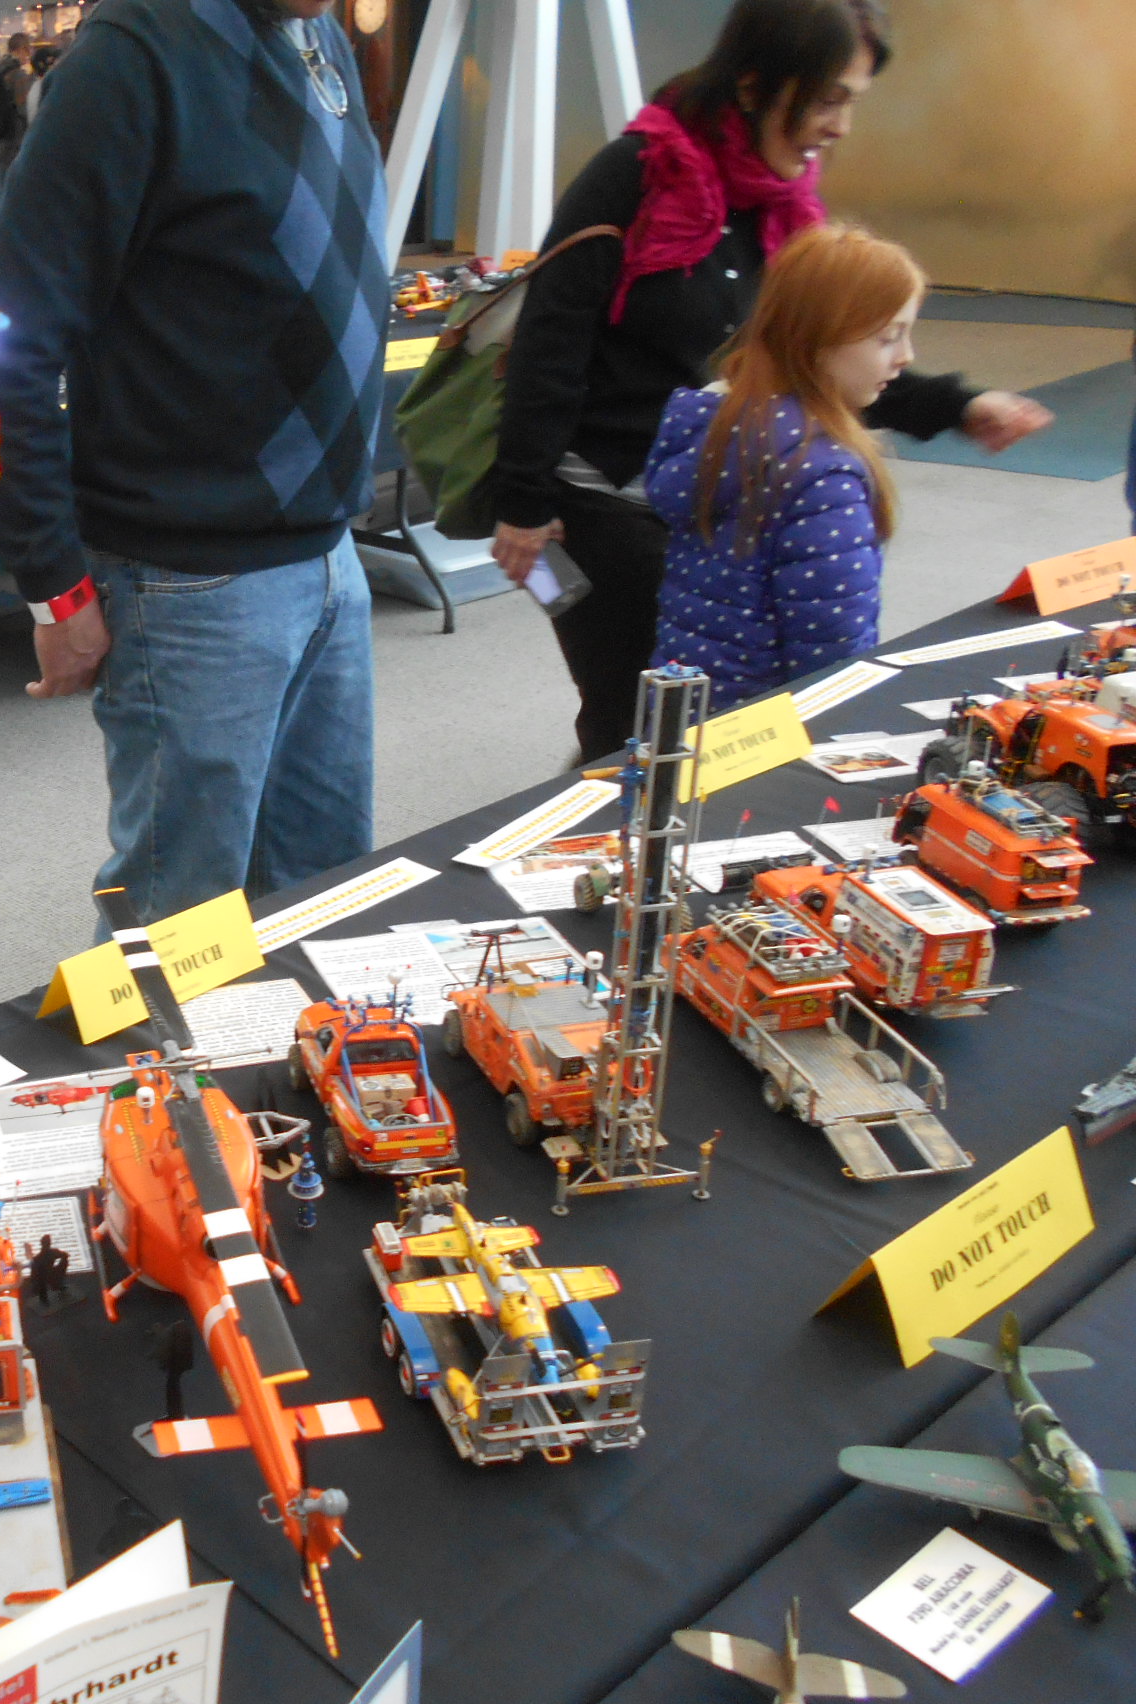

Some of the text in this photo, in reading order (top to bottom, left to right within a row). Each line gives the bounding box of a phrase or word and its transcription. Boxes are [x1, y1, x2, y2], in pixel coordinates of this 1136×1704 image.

[712, 742, 738, 760] NOT
[737, 727, 778, 752] TOUCH
[109, 943, 224, 1005] DO TOUCH
[930, 1259, 957, 1293] DO
[958, 1232, 995, 1273] NOT
[995, 1191, 1052, 1244] TOUCH
[913, 1574, 936, 1592] BELL
[929, 1563, 977, 1606] AIRACOBRA
